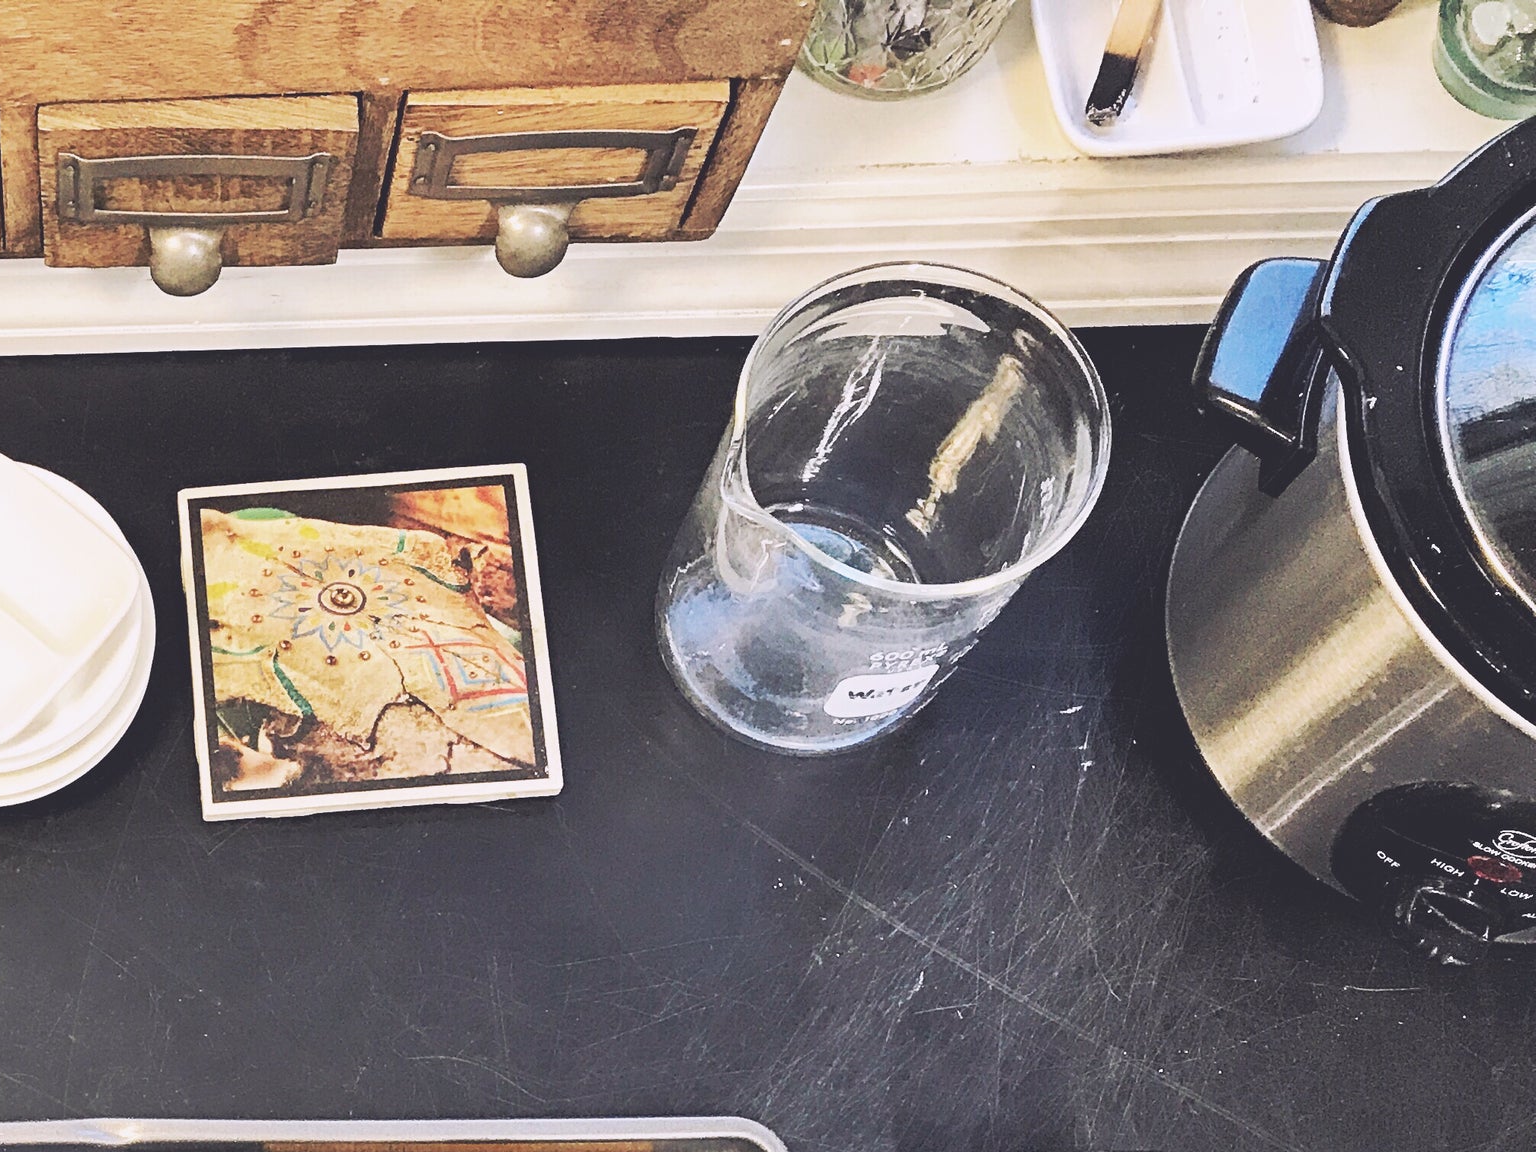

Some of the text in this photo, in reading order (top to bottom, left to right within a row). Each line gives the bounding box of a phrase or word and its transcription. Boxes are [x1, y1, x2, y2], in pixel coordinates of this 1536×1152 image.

[869, 651, 915, 661] 600
[1472, 841, 1501, 856] SLOW
[1376, 850, 1401, 868] OFF
[1430, 858, 1465, 877] HIGH
[1500, 887, 1534, 899] LOW
